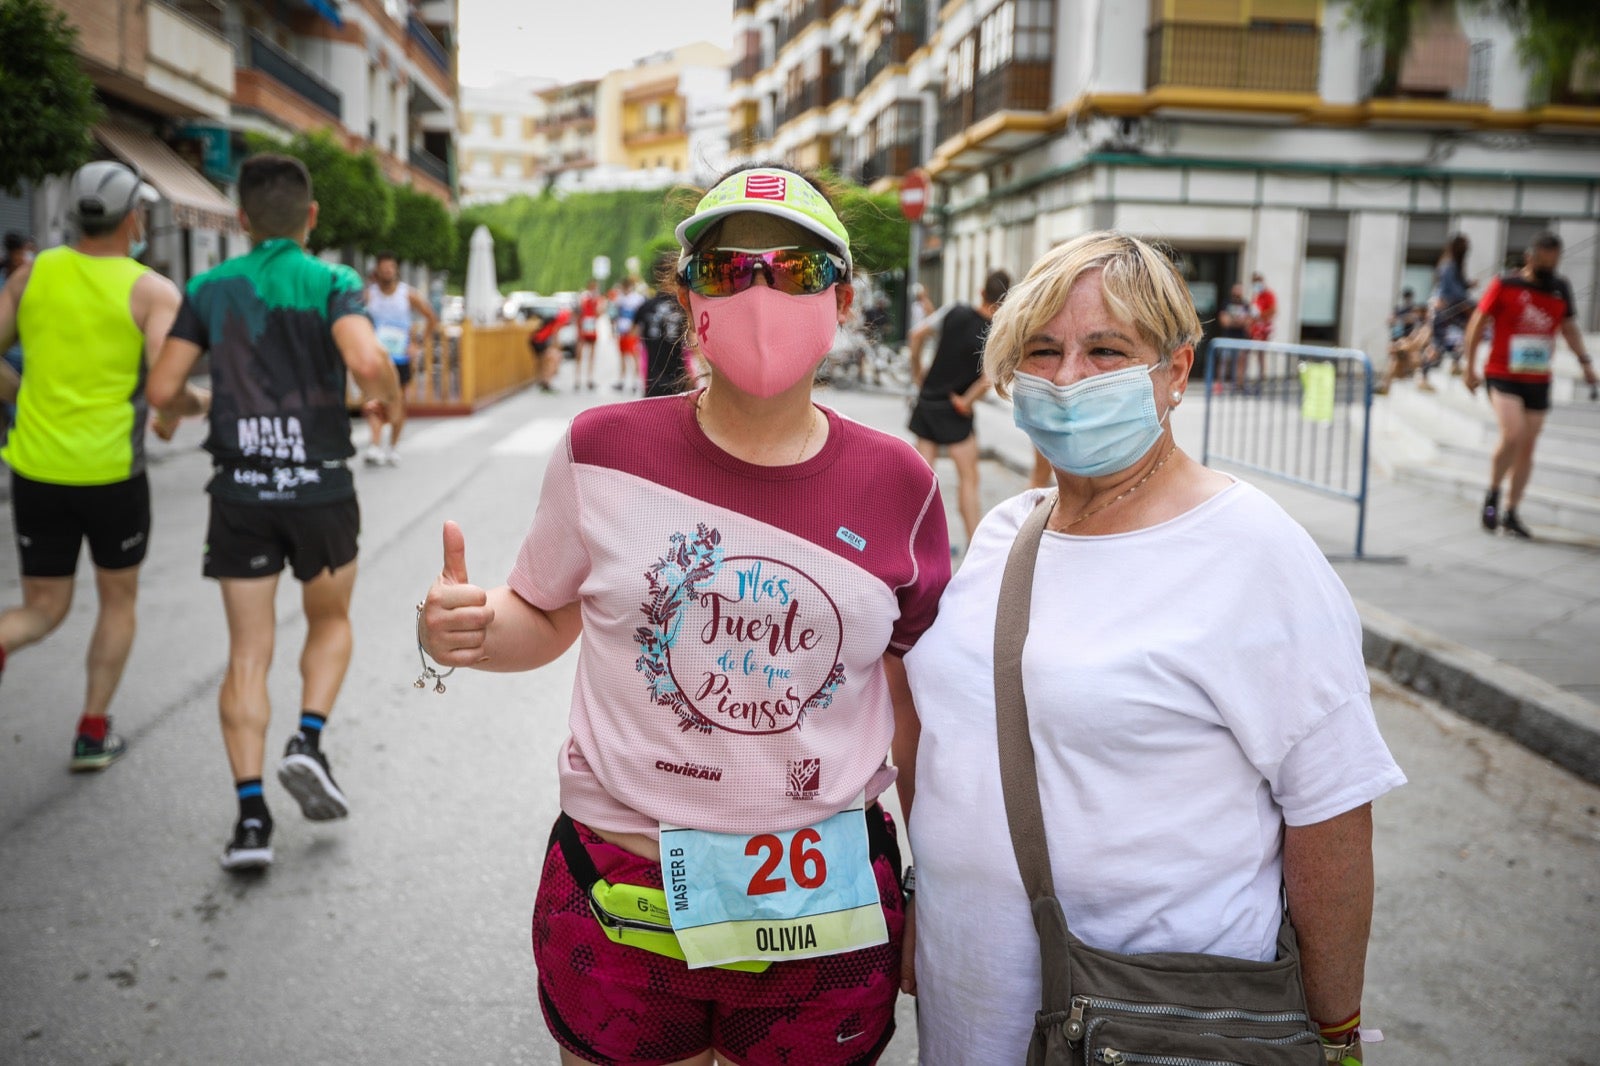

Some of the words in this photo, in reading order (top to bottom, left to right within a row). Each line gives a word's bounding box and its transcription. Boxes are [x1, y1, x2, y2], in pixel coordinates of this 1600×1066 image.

[736, 561, 793, 604] Más
[700, 592, 822, 656] Fuerte
[717, 649, 735, 672] de
[743, 648, 758, 675] lo
[763, 664, 792, 688] que
[695, 671, 800, 728] Piensas
[670, 847, 684, 857] B
[744, 828, 827, 896] 26
[671, 859, 689, 911] MASTER
[756, 924, 817, 952] OLIVIA
